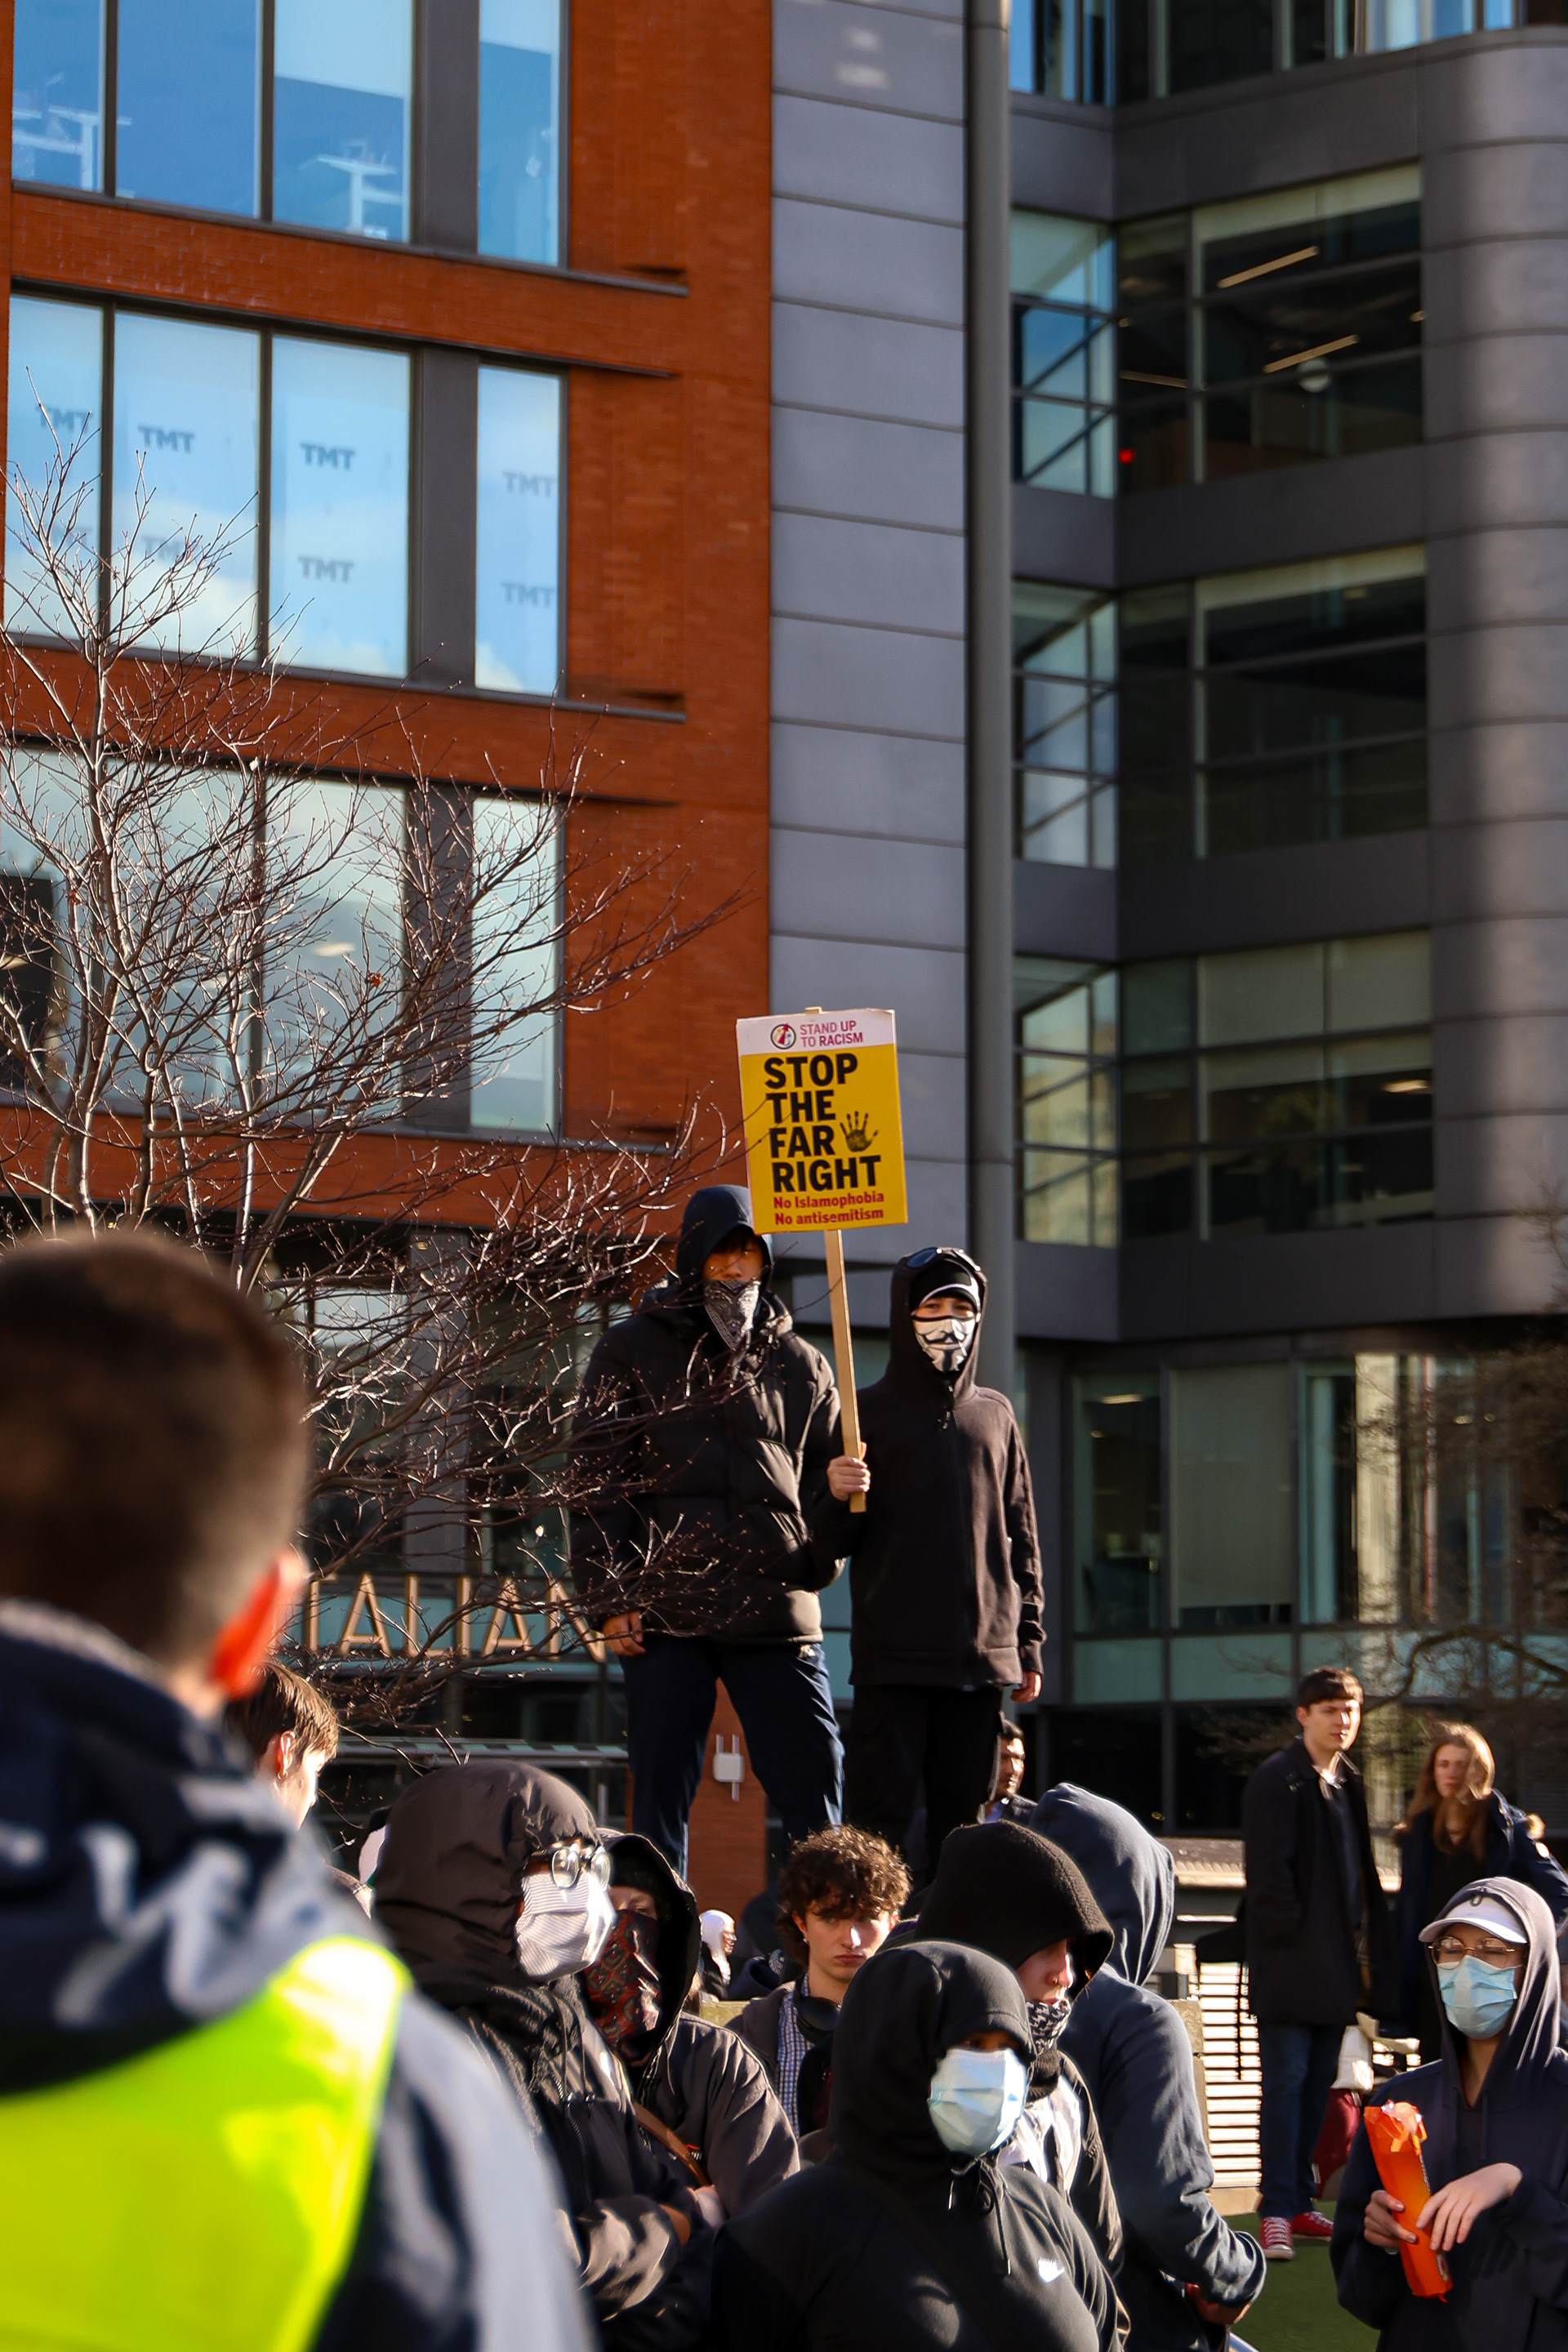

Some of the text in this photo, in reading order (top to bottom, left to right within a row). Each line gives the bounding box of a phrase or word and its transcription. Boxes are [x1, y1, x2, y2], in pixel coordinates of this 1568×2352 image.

[137, 423, 195, 453] TMT
[300, 441, 356, 471] TMT
[502, 470, 556, 499] TMT
[140, 534, 193, 564] TM
[297, 555, 355, 584] TMT
[501, 581, 555, 608] TMT
[800, 1019, 857, 1036] STAND UP
[800, 1031, 864, 1048] TO RACISM
[764, 1053, 858, 1089] STOP
[765, 1089, 836, 1125] THE
[768, 1125, 836, 1159] FAR
[771, 1155, 882, 1193] RIGHT
[773, 1190, 885, 1209] No Islamophobia
[774, 1208, 884, 1225] No antisemitism
[304, 1569, 606, 1663] TALIAN
